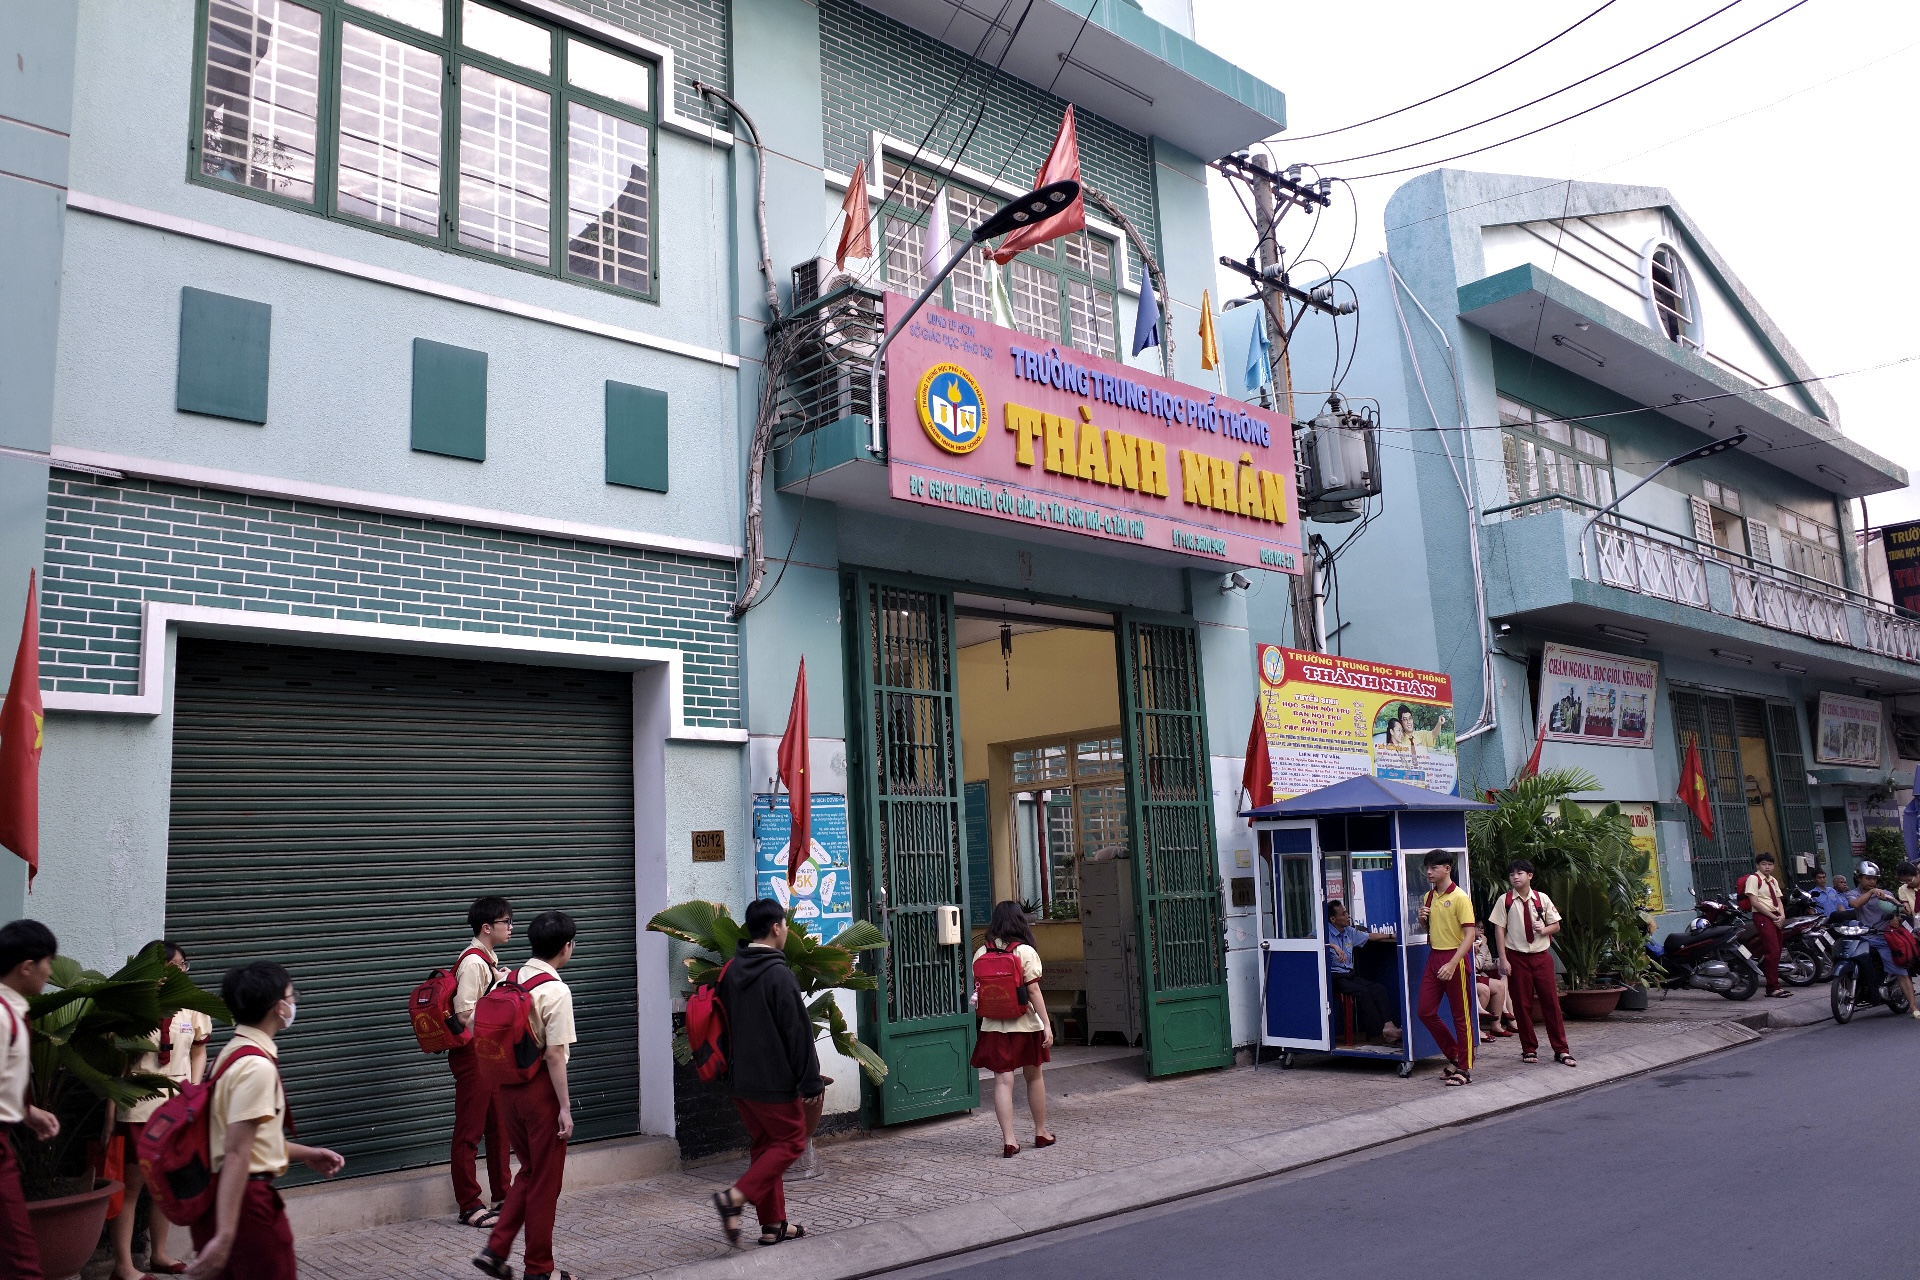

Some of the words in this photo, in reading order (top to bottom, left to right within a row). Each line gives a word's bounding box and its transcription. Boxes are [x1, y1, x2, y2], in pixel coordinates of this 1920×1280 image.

[1010, 346, 1090, 396] TRƯỜNG
[1090, 370, 1149, 414] TRUNG
[1151, 388, 1186, 427] HỌC
[1186, 394, 1220, 434] PHỔ
[1219, 408, 1272, 448] THÔNG
[1004, 402, 1170, 498] THÀNH
[1180, 450, 1288, 525] NHÂN
[928, 478, 955, 503] 69/12
[956, 483, 994, 511] NGUYỄN
[995, 488, 1015, 515] CỬU
[1067, 506, 1085, 528] SƠN
[1129, 519, 1146, 541] PHÚ
[1891, 526, 1920, 544] TRƯỜ
[1288, 651, 1333, 667] TRƯỜNG
[1335, 659, 1370, 673] TRUNG
[1372, 666, 1393, 677] HỌC
[1395, 668, 1415, 679] PHỔ
[1417, 673, 1447, 685] THÔNG
[1593, 665, 1607, 684] HỌC
[1303, 666, 1379, 690] THÀNH
[1382, 678, 1437, 699] NHÂN
[1282, 701, 1299, 709] HỌC
[1300, 703, 1319, 711] SINH
[1320, 705, 1334, 713] NỘI
[1294, 692, 1319, 703] TUYỂN
[695, 834, 721, 848] 69/12
[797, 875, 813, 888] 5K
